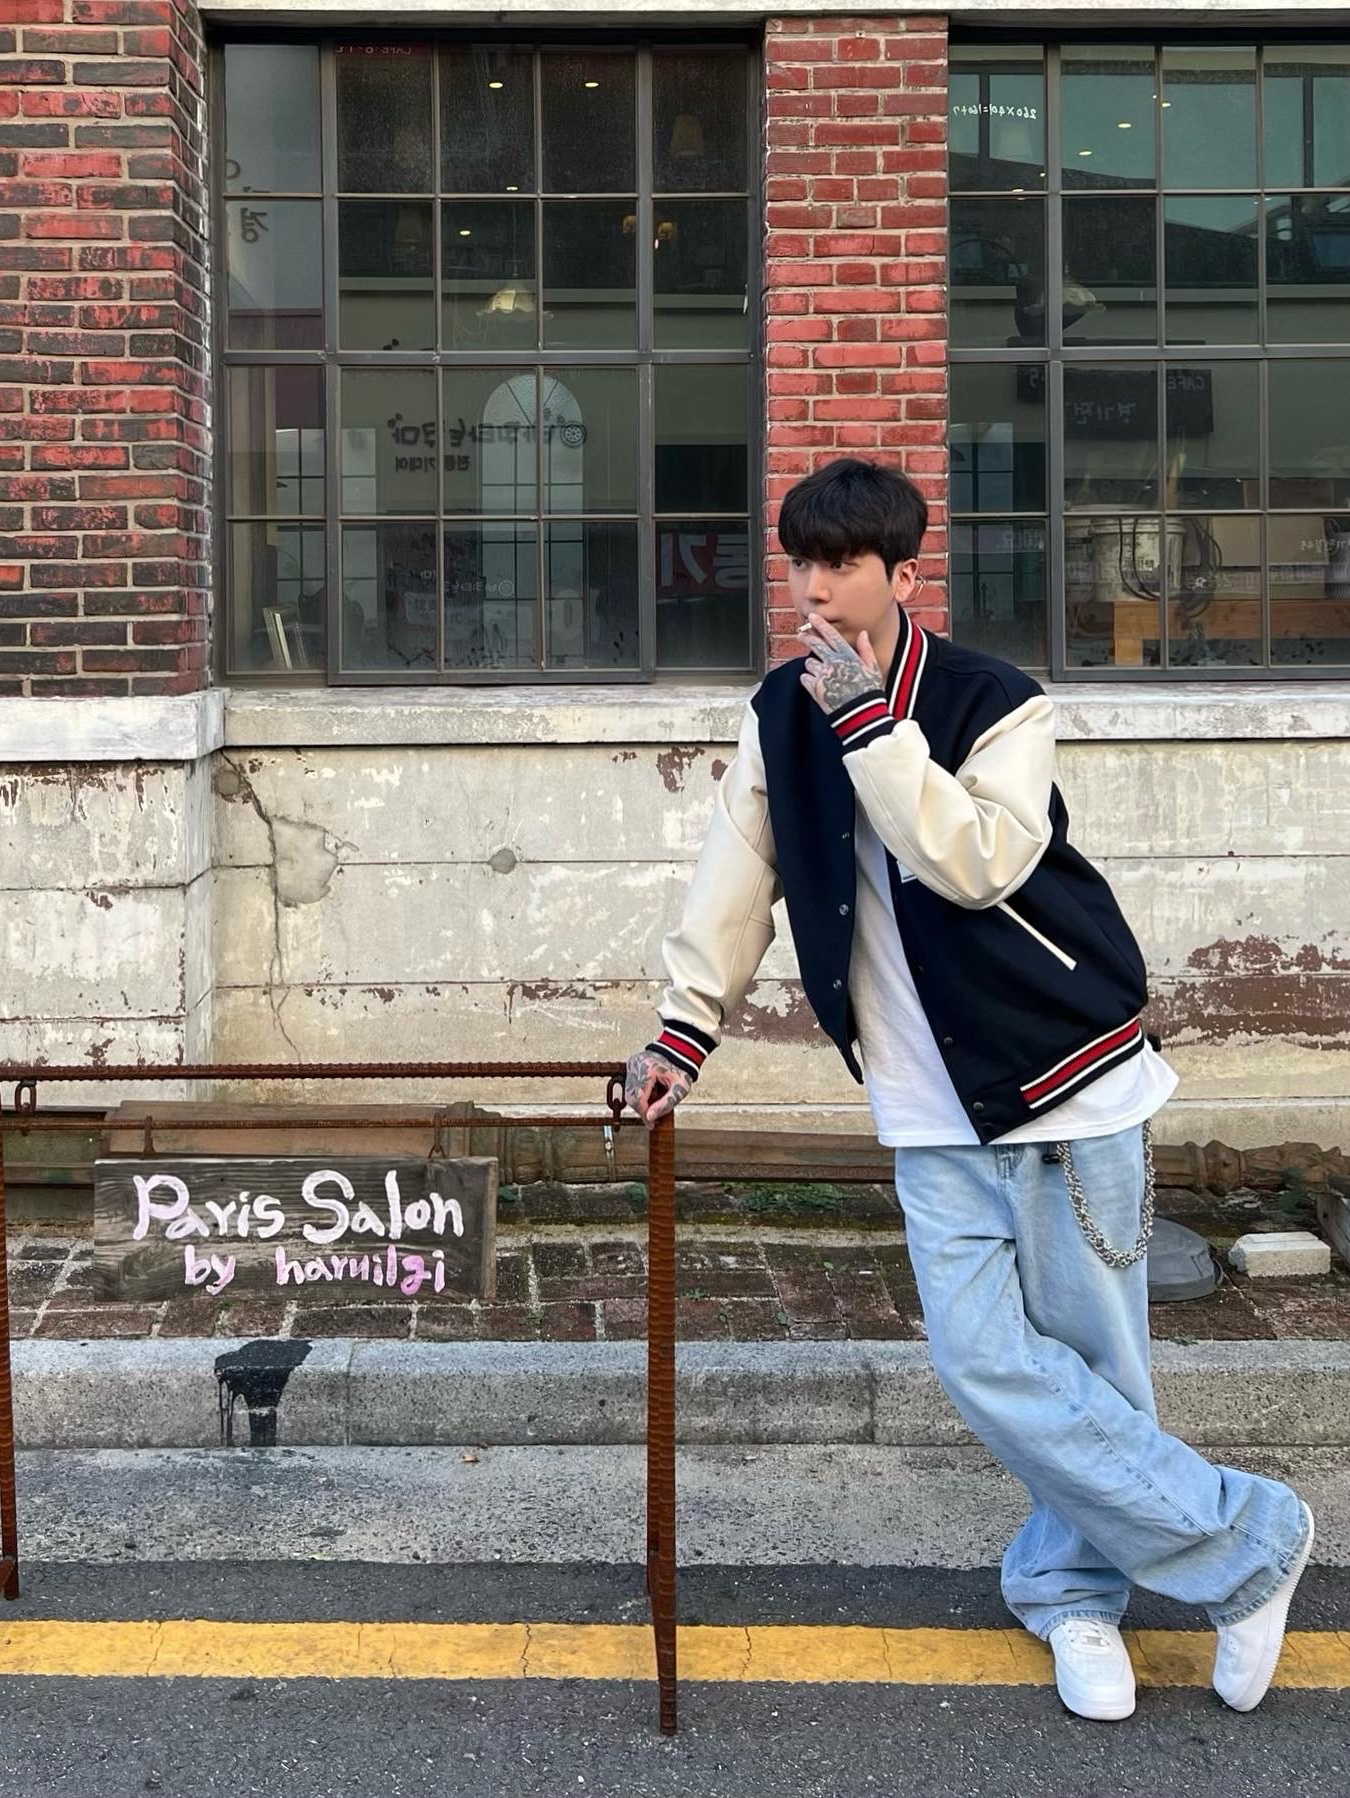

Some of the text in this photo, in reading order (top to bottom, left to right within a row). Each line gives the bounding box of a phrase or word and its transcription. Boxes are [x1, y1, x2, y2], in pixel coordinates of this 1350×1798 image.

[133, 1169, 464, 1244] Paris Salon
[184, 1244, 445, 1295] by haruilgi
